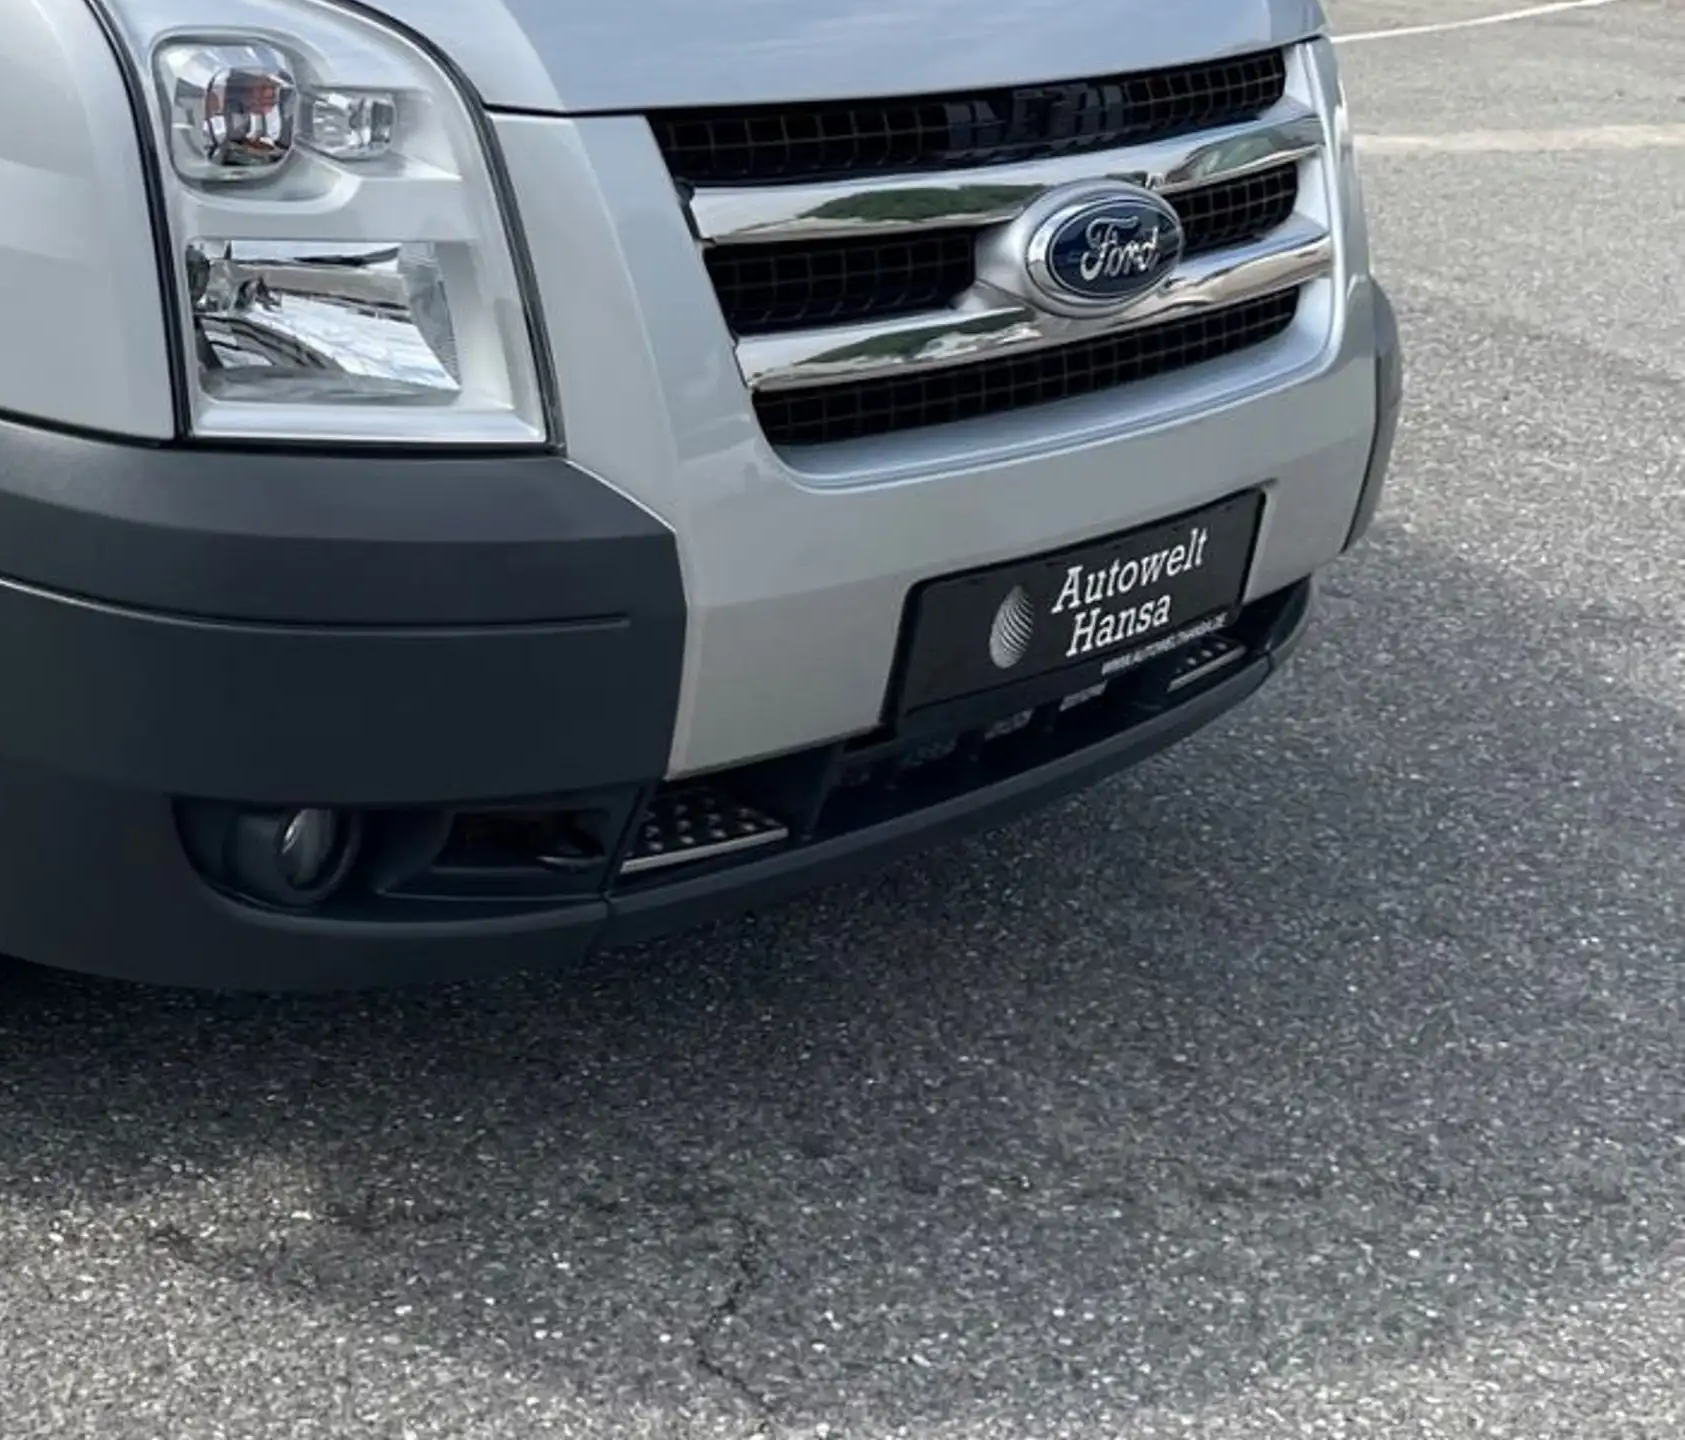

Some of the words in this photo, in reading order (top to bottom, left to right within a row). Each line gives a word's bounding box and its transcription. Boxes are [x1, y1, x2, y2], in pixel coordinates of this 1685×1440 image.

[1079, 215, 1160, 281] Ford
[1051, 527, 1209, 614] Autowelt
[1065, 593, 1172, 658] Hansa
